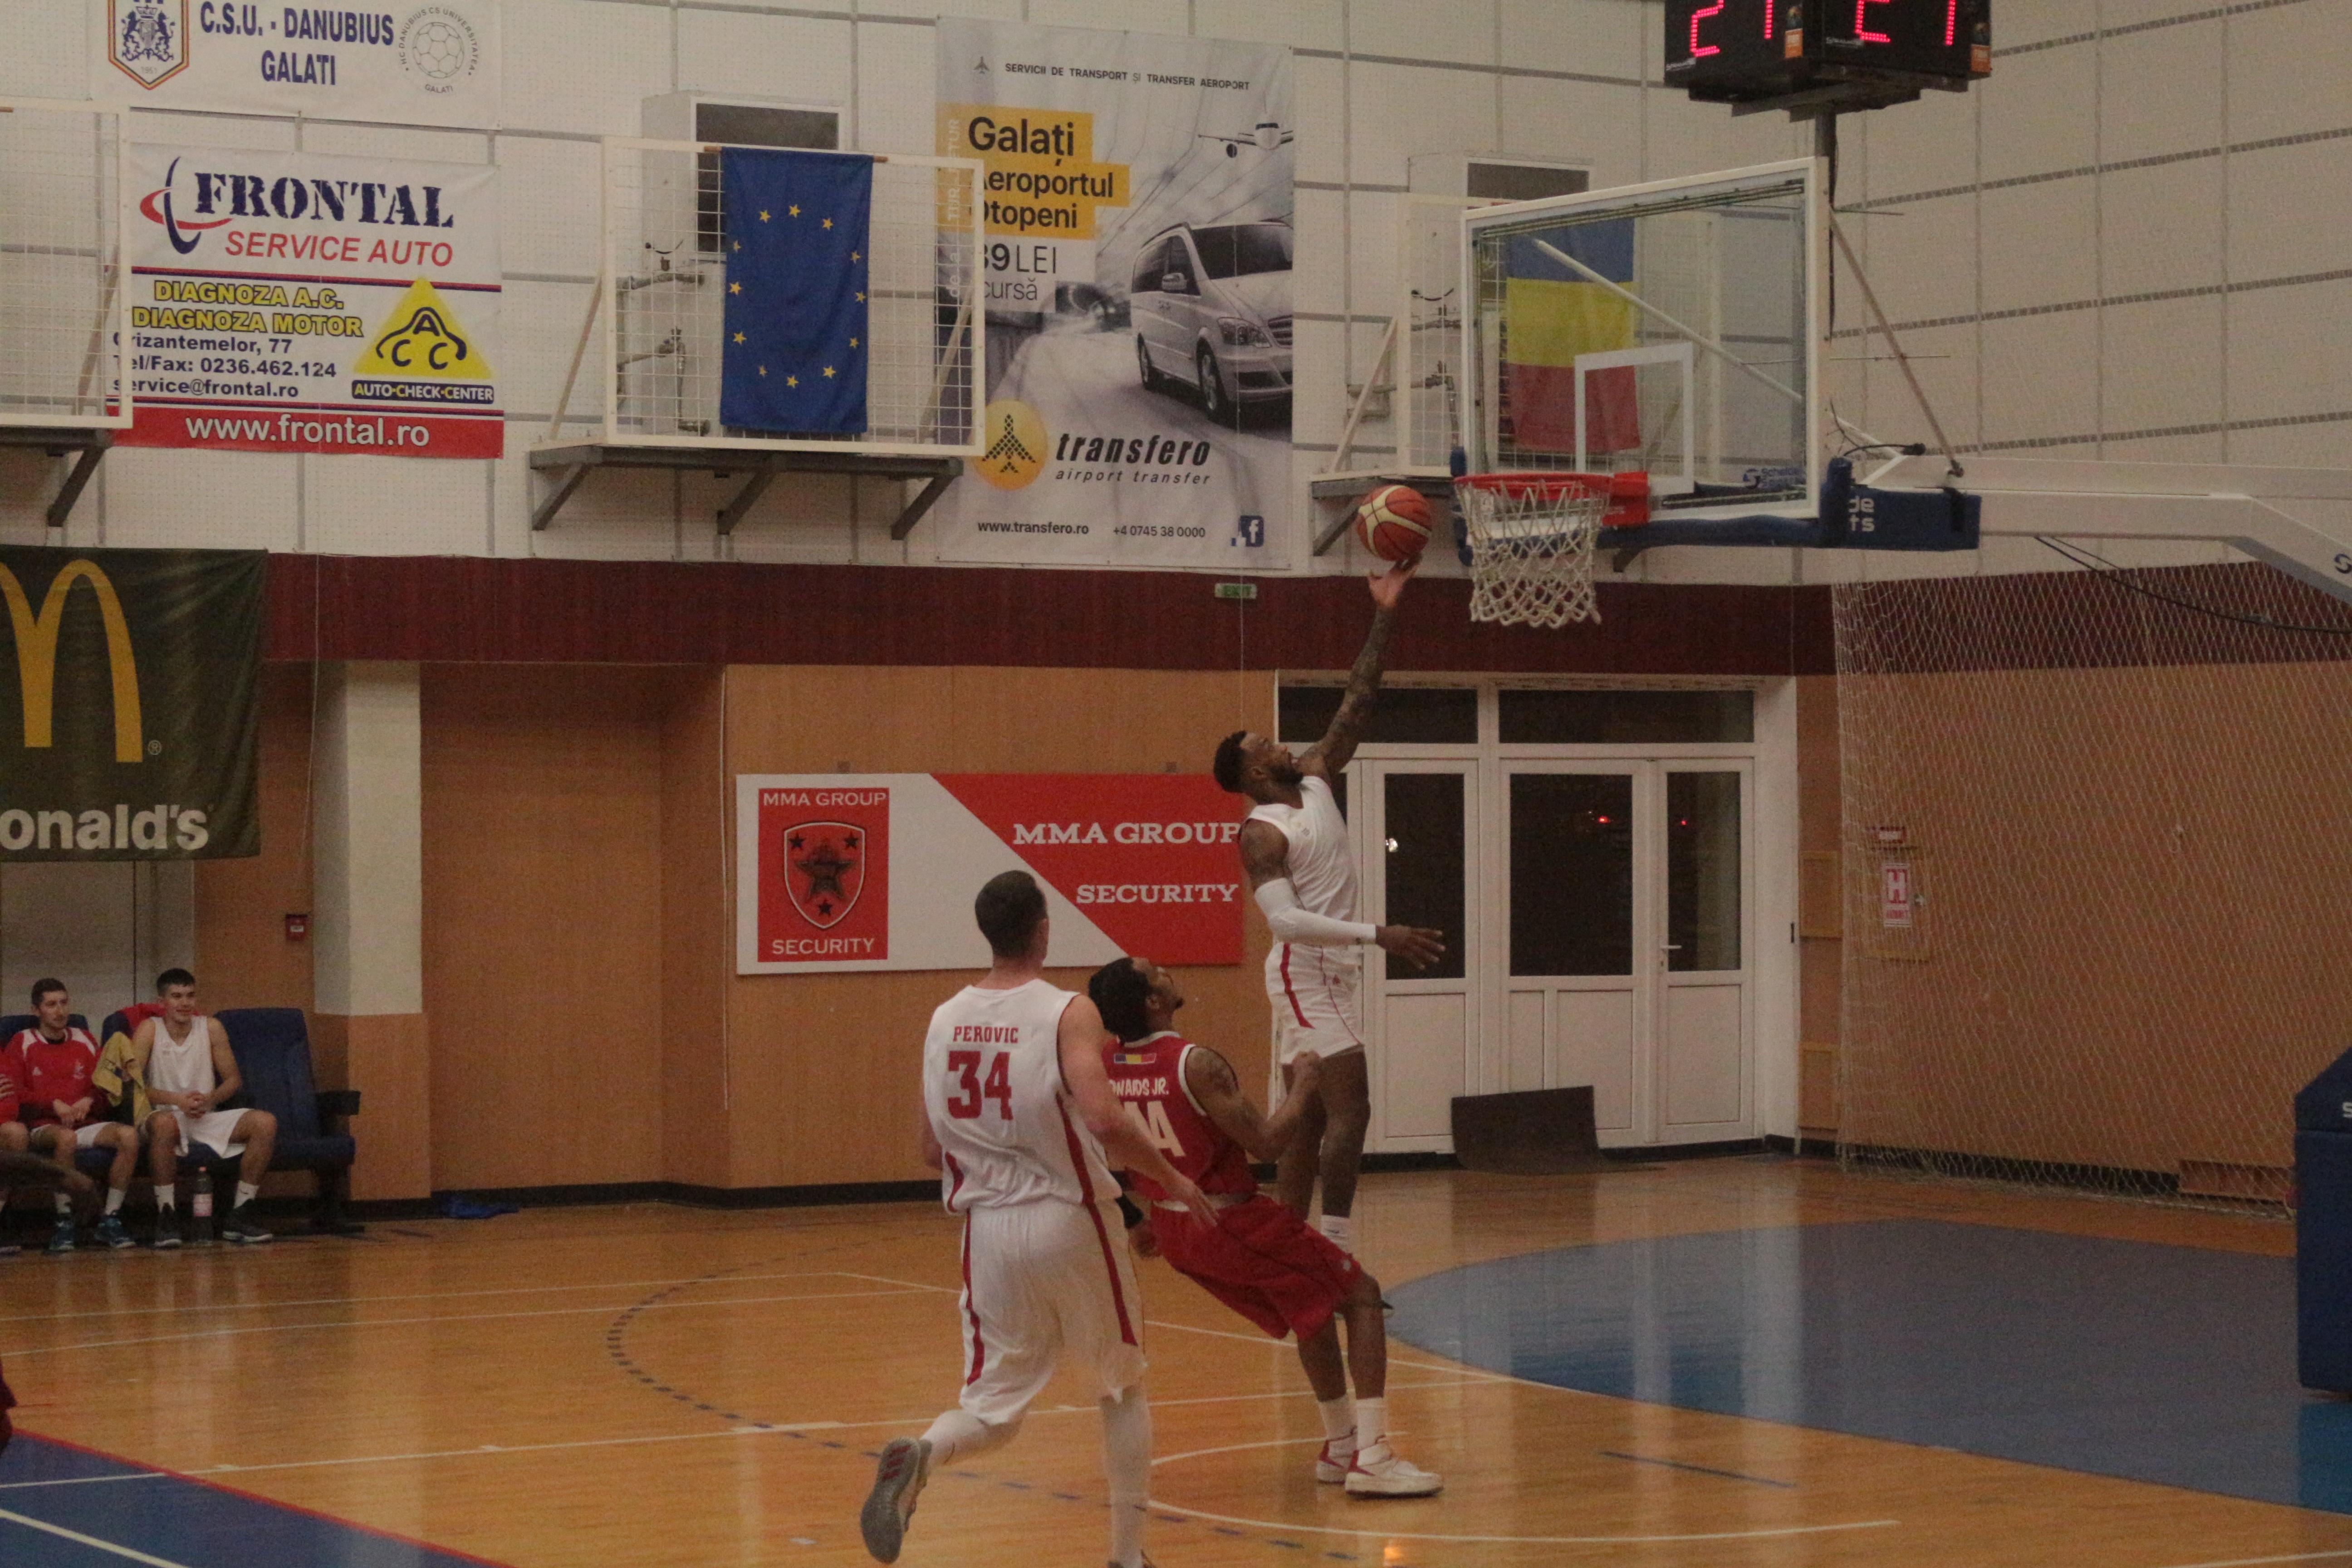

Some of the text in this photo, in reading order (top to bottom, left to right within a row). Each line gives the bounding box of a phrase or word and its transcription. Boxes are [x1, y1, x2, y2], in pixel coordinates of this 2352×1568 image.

[201, 2, 264, 36] C.S.U.
[283, 7, 394, 45] DANUBIUS
[399, 9, 426, 49] DANUBIUS
[443, 8, 478, 70] UNIVERSITATEA
[261, 50, 336, 86] GALATI
[399, 52, 407, 64] HC
[425, 84, 453, 93] GALATI
[1005, 64, 1046, 75] SERVICII
[1051, 67, 1064, 76] DE
[1070, 69, 1127, 81] TRANSPORT
[1147, 74, 1196, 86] TRANSFER
[1200, 78, 1250, 90] AEROPORT
[968, 117, 1074, 166] Galați
[970, 172, 1114, 199] eroportul
[194, 172, 454, 228] FRONTAL
[225, 230, 453, 267] SERVICE AUTO
[1016, 245, 1057, 274] LEI
[154, 279, 344, 309] DIAGNOZA A.C.
[132, 307, 364, 338] DIAGNOZA MOTOR
[269, 339, 293, 353] 77
[201, 358, 337, 378] 0236.462.124
[186, 416, 430, 447] www.frontal.ro
[1056, 433, 1210, 466] transfero
[1056, 469, 1211, 485] airport transfer
[978, 522, 1206, 537] www.transfero.ro +4 0745 38 0000
[763, 792, 887, 806] MMA GROUP
[1013, 822, 1242, 845] MMA GROUP
[1076, 884, 1239, 904] SECURITY
[772, 938, 875, 955] SECURITY
[953, 1026, 1019, 1044] PEROVIC
[947, 1050, 1014, 1121] 34
[1152, 1077, 1170, 1096] JR.
